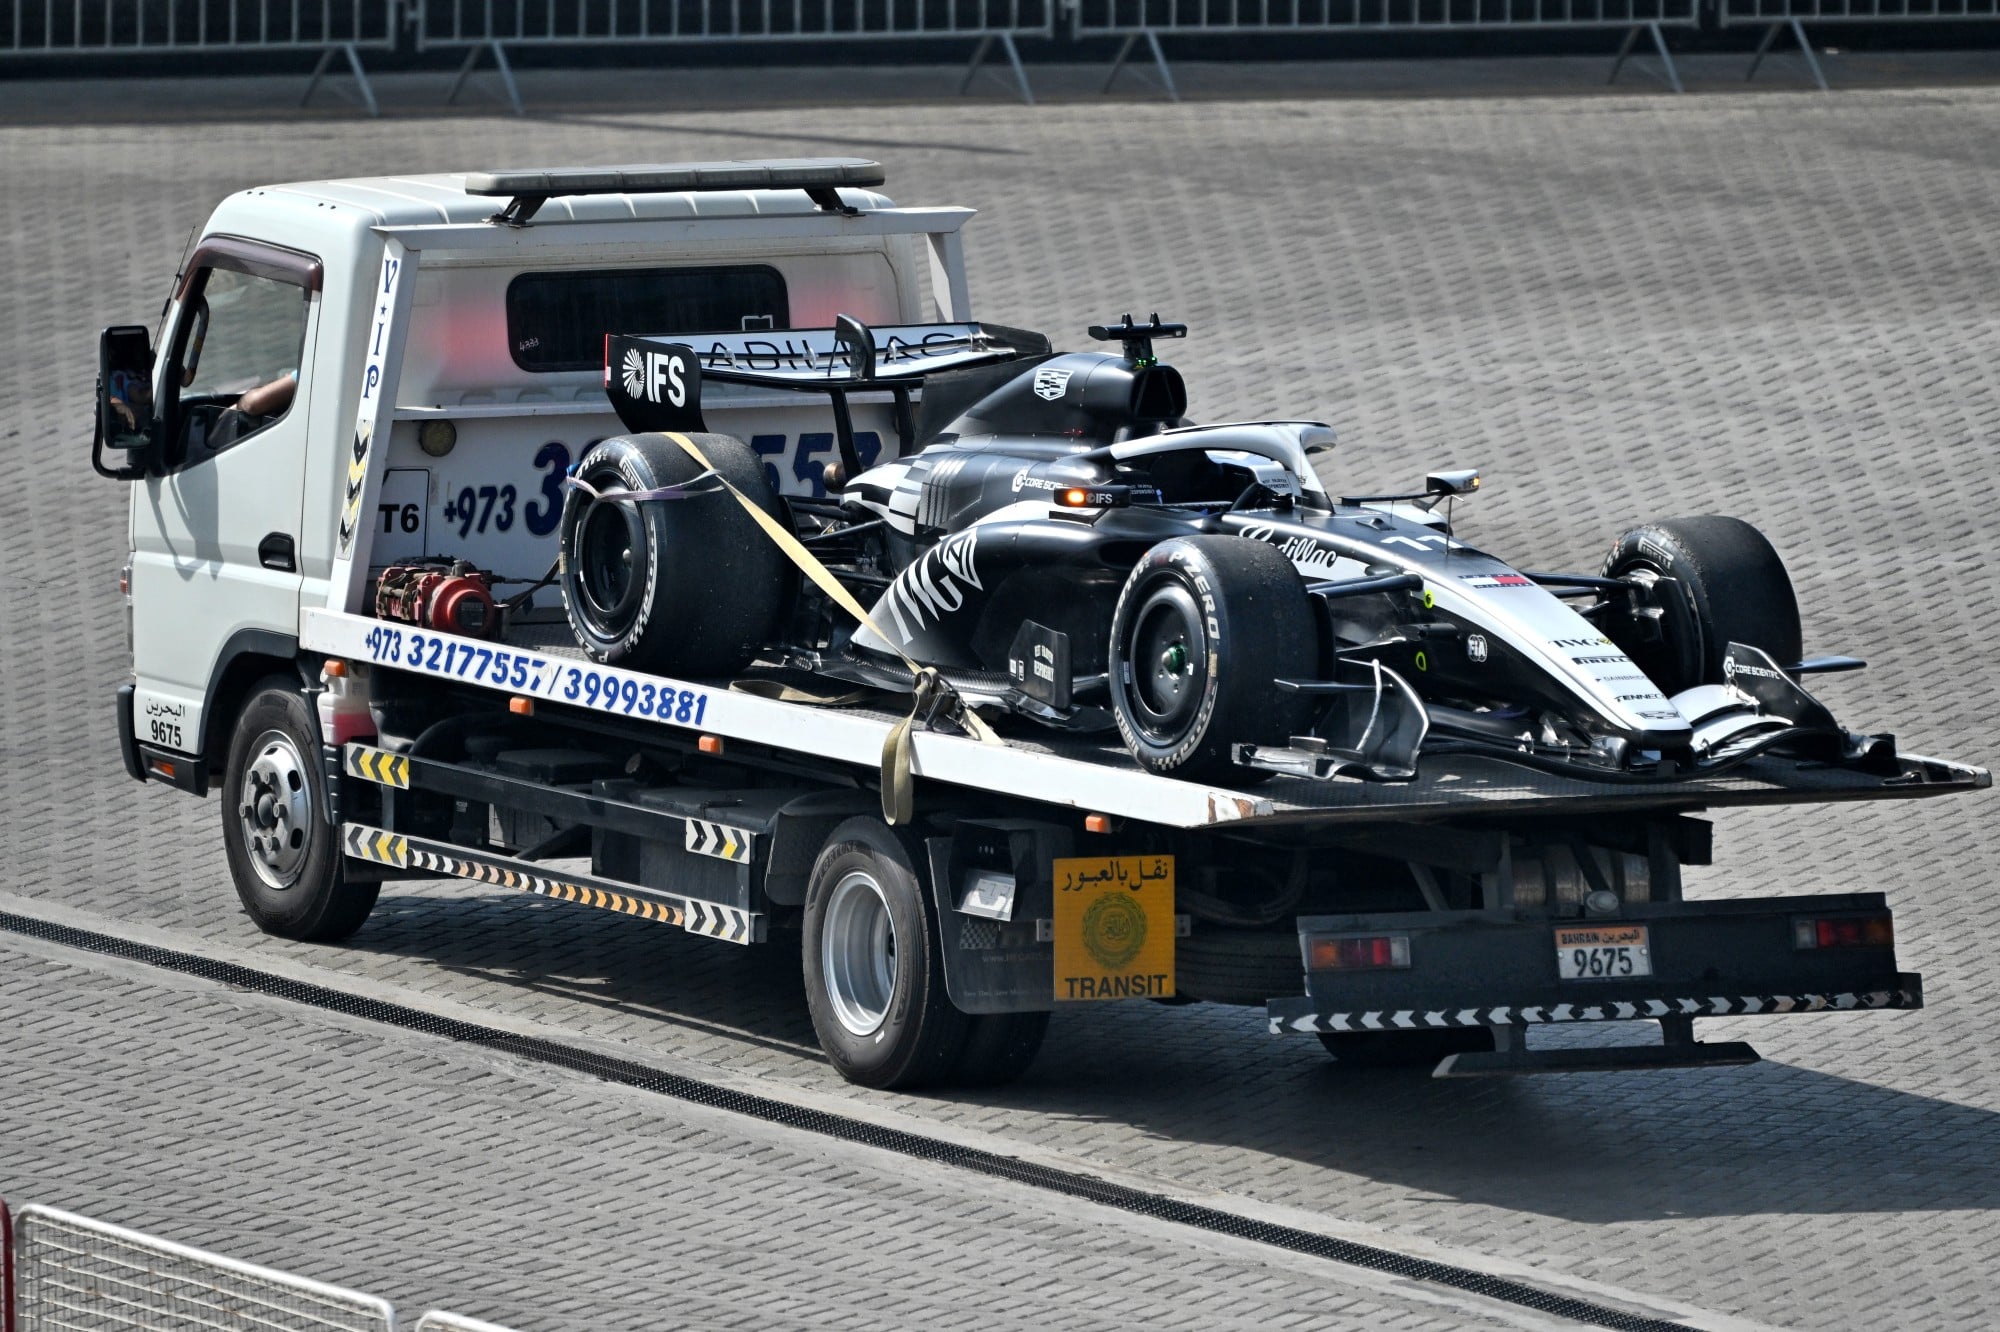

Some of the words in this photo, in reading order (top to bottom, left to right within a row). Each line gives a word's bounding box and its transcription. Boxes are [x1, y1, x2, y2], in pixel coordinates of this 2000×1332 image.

[646, 351, 686, 408] IFS
[1025, 477, 1045, 489] CORE
[1095, 493, 1113, 504] IFS
[378, 503, 420, 534] T6
[444, 484, 517, 540] +973
[1380, 535, 1465, 551] 11
[1168, 550, 1185, 564] P
[1183, 562, 1221, 640] ZERO
[365, 626, 402, 663] +973
[407, 634, 548, 692] 32177557
[564, 668, 709, 727] 39993881
[1735, 664, 1753, 676] CORE
[145, 697, 186, 722] البحرين
[151, 719, 182, 748] 9675
[1561, 932, 1600, 945] BAHRAIN
[1602, 928, 1640, 945] البحرين
[1574, 947, 1633, 977] 9675
[1064, 974, 1168, 998] TRANSIT
